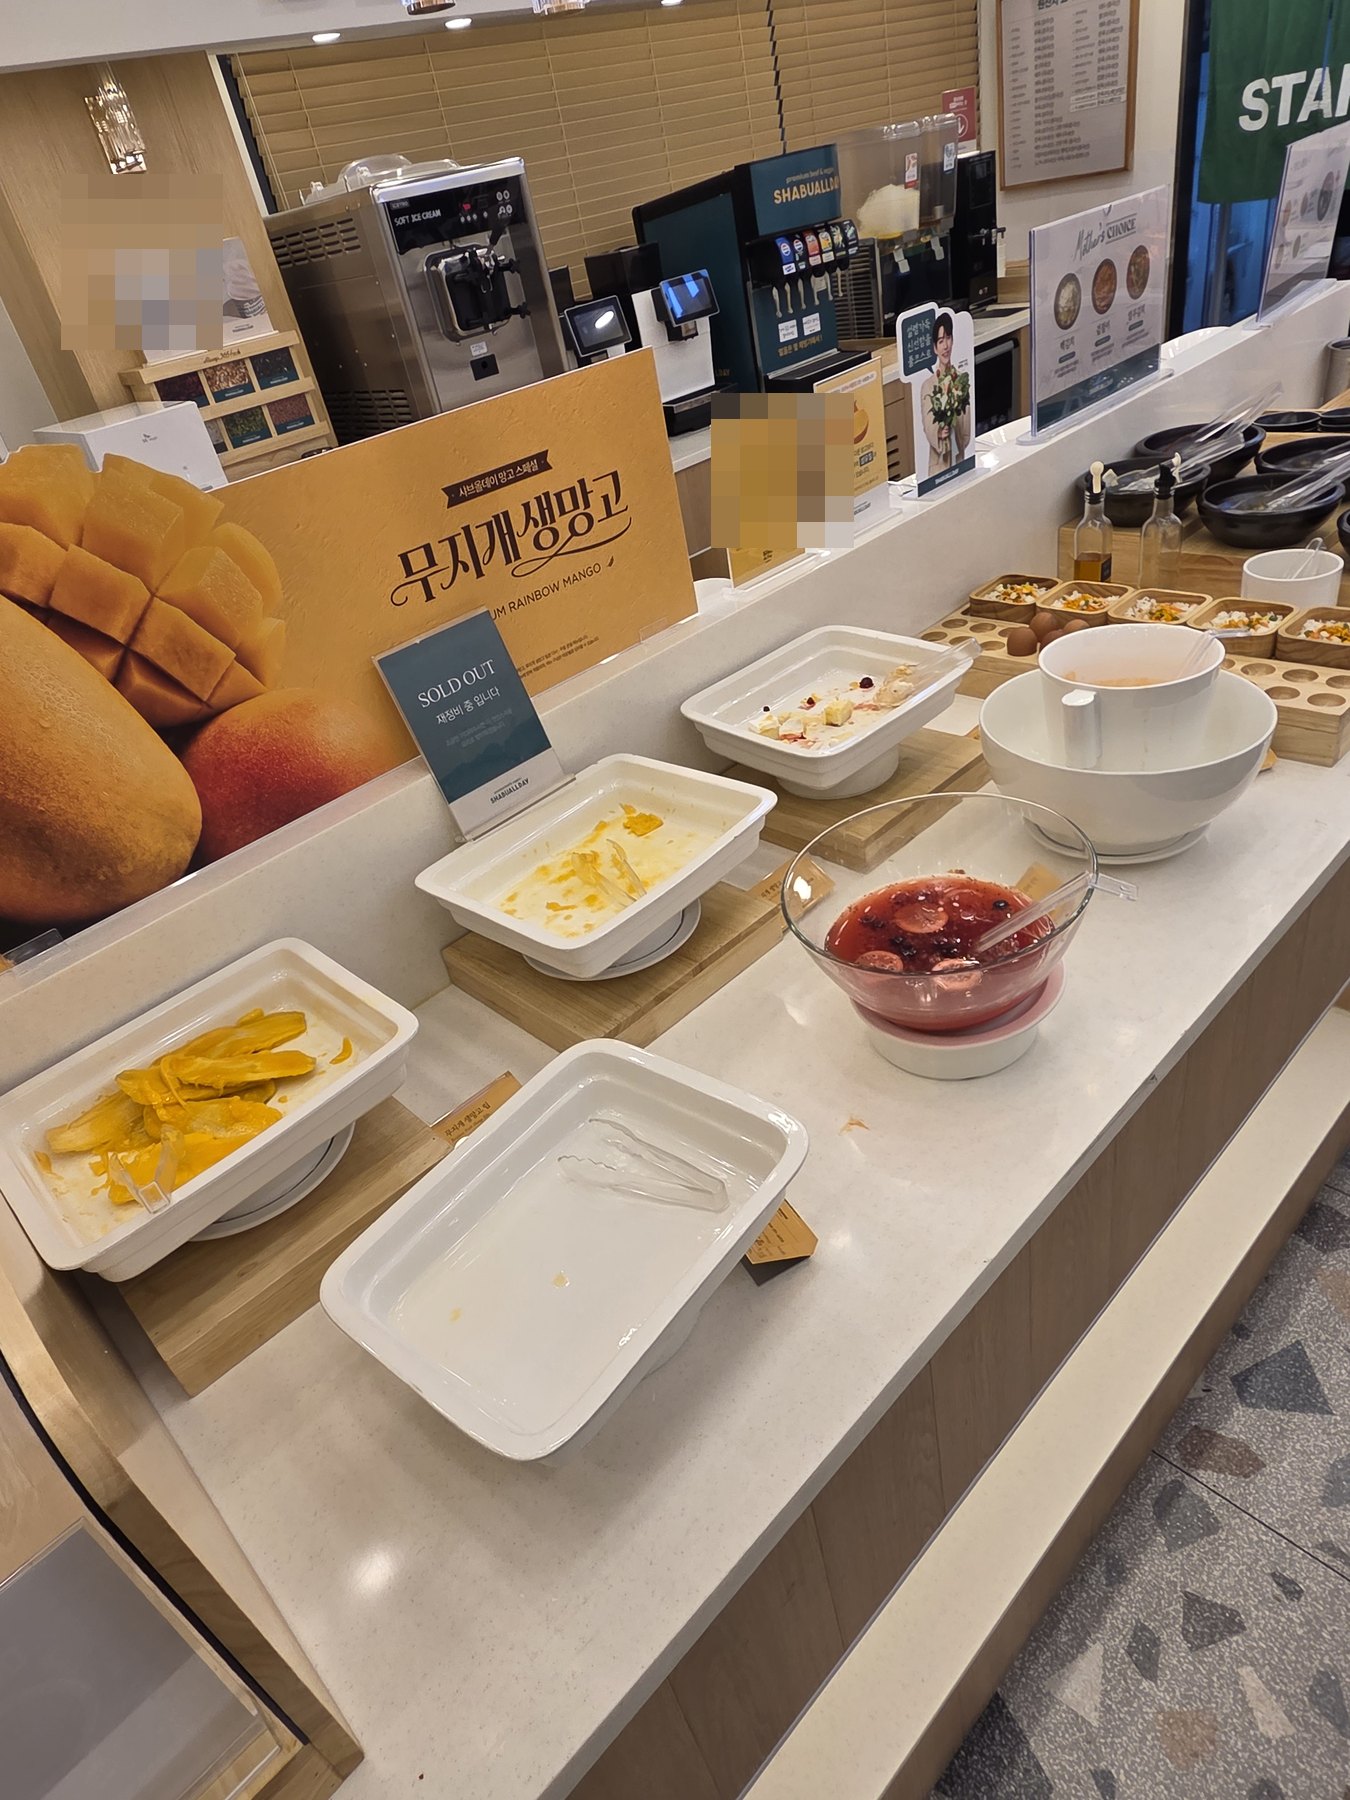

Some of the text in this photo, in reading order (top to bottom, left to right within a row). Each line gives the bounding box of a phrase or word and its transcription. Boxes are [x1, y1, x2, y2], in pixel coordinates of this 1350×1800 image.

[395, 209, 441, 226] SOFT ICE CREAM
[1072, 217, 1137, 262] Mother's CHOICE
[498, 469, 515, 486] 망고
[508, 582, 560, 612] RAINBOW
[562, 563, 602, 589] MANGO
[417, 659, 496, 708] SOLD OUT
[436, 686, 500, 725] 재정비 중 입니다
